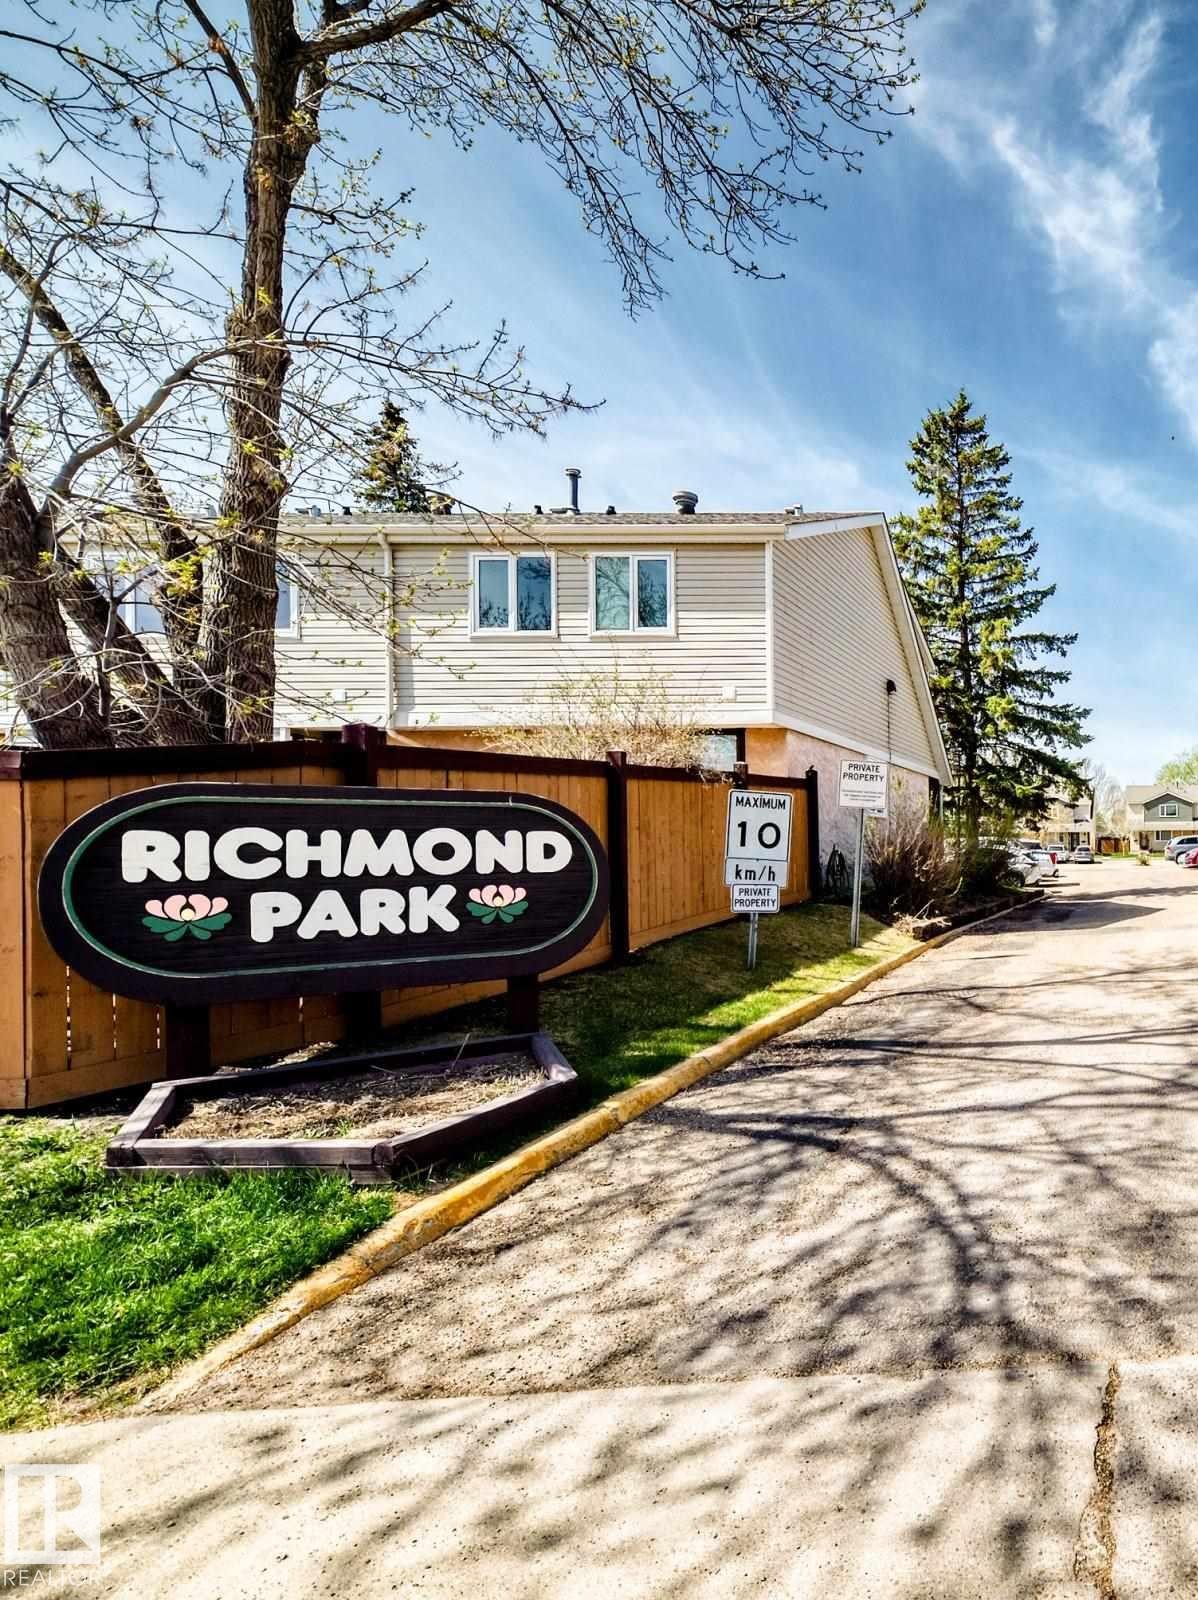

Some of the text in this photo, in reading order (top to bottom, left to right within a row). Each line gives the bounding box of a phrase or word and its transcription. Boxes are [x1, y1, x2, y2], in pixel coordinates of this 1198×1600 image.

[848, 763, 881, 773] PRIVATE
[843, 773, 885, 782] PROPERTY
[735, 796, 786, 810] MAXIMUM
[737, 821, 781, 849] 10
[121, 827, 573, 883] RICHMOND
[734, 864, 776, 882] km/h
[738, 887, 772, 897] PRIVATE
[734, 898, 776, 908] PROPERTY
[250, 885, 460, 942] PARK
